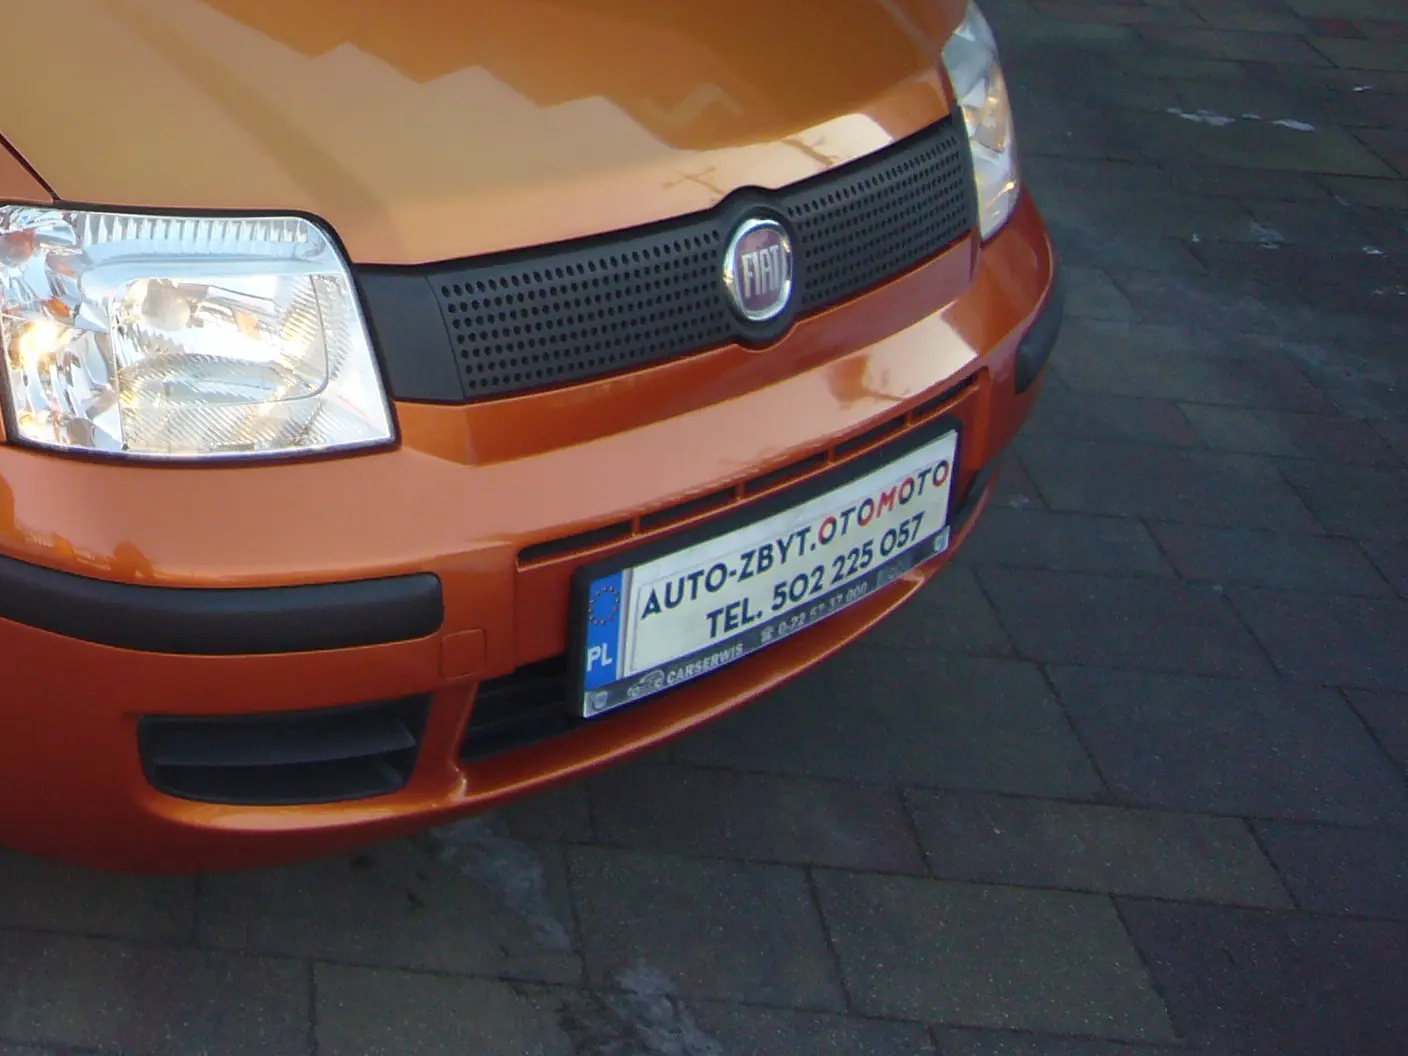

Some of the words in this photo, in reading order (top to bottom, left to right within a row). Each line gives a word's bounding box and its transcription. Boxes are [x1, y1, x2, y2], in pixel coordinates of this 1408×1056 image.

[741, 245, 779, 298] FIAT
[641, 459, 949, 620] AUTO-ZBYT.OTOMOTO
[706, 596, 763, 638] TEL.
[771, 564, 826, 612] 502
[831, 539, 874, 584] 225
[880, 512, 925, 557] 057
[586, 643, 613, 672] PL
[666, 643, 744, 685] CARSERWIS
